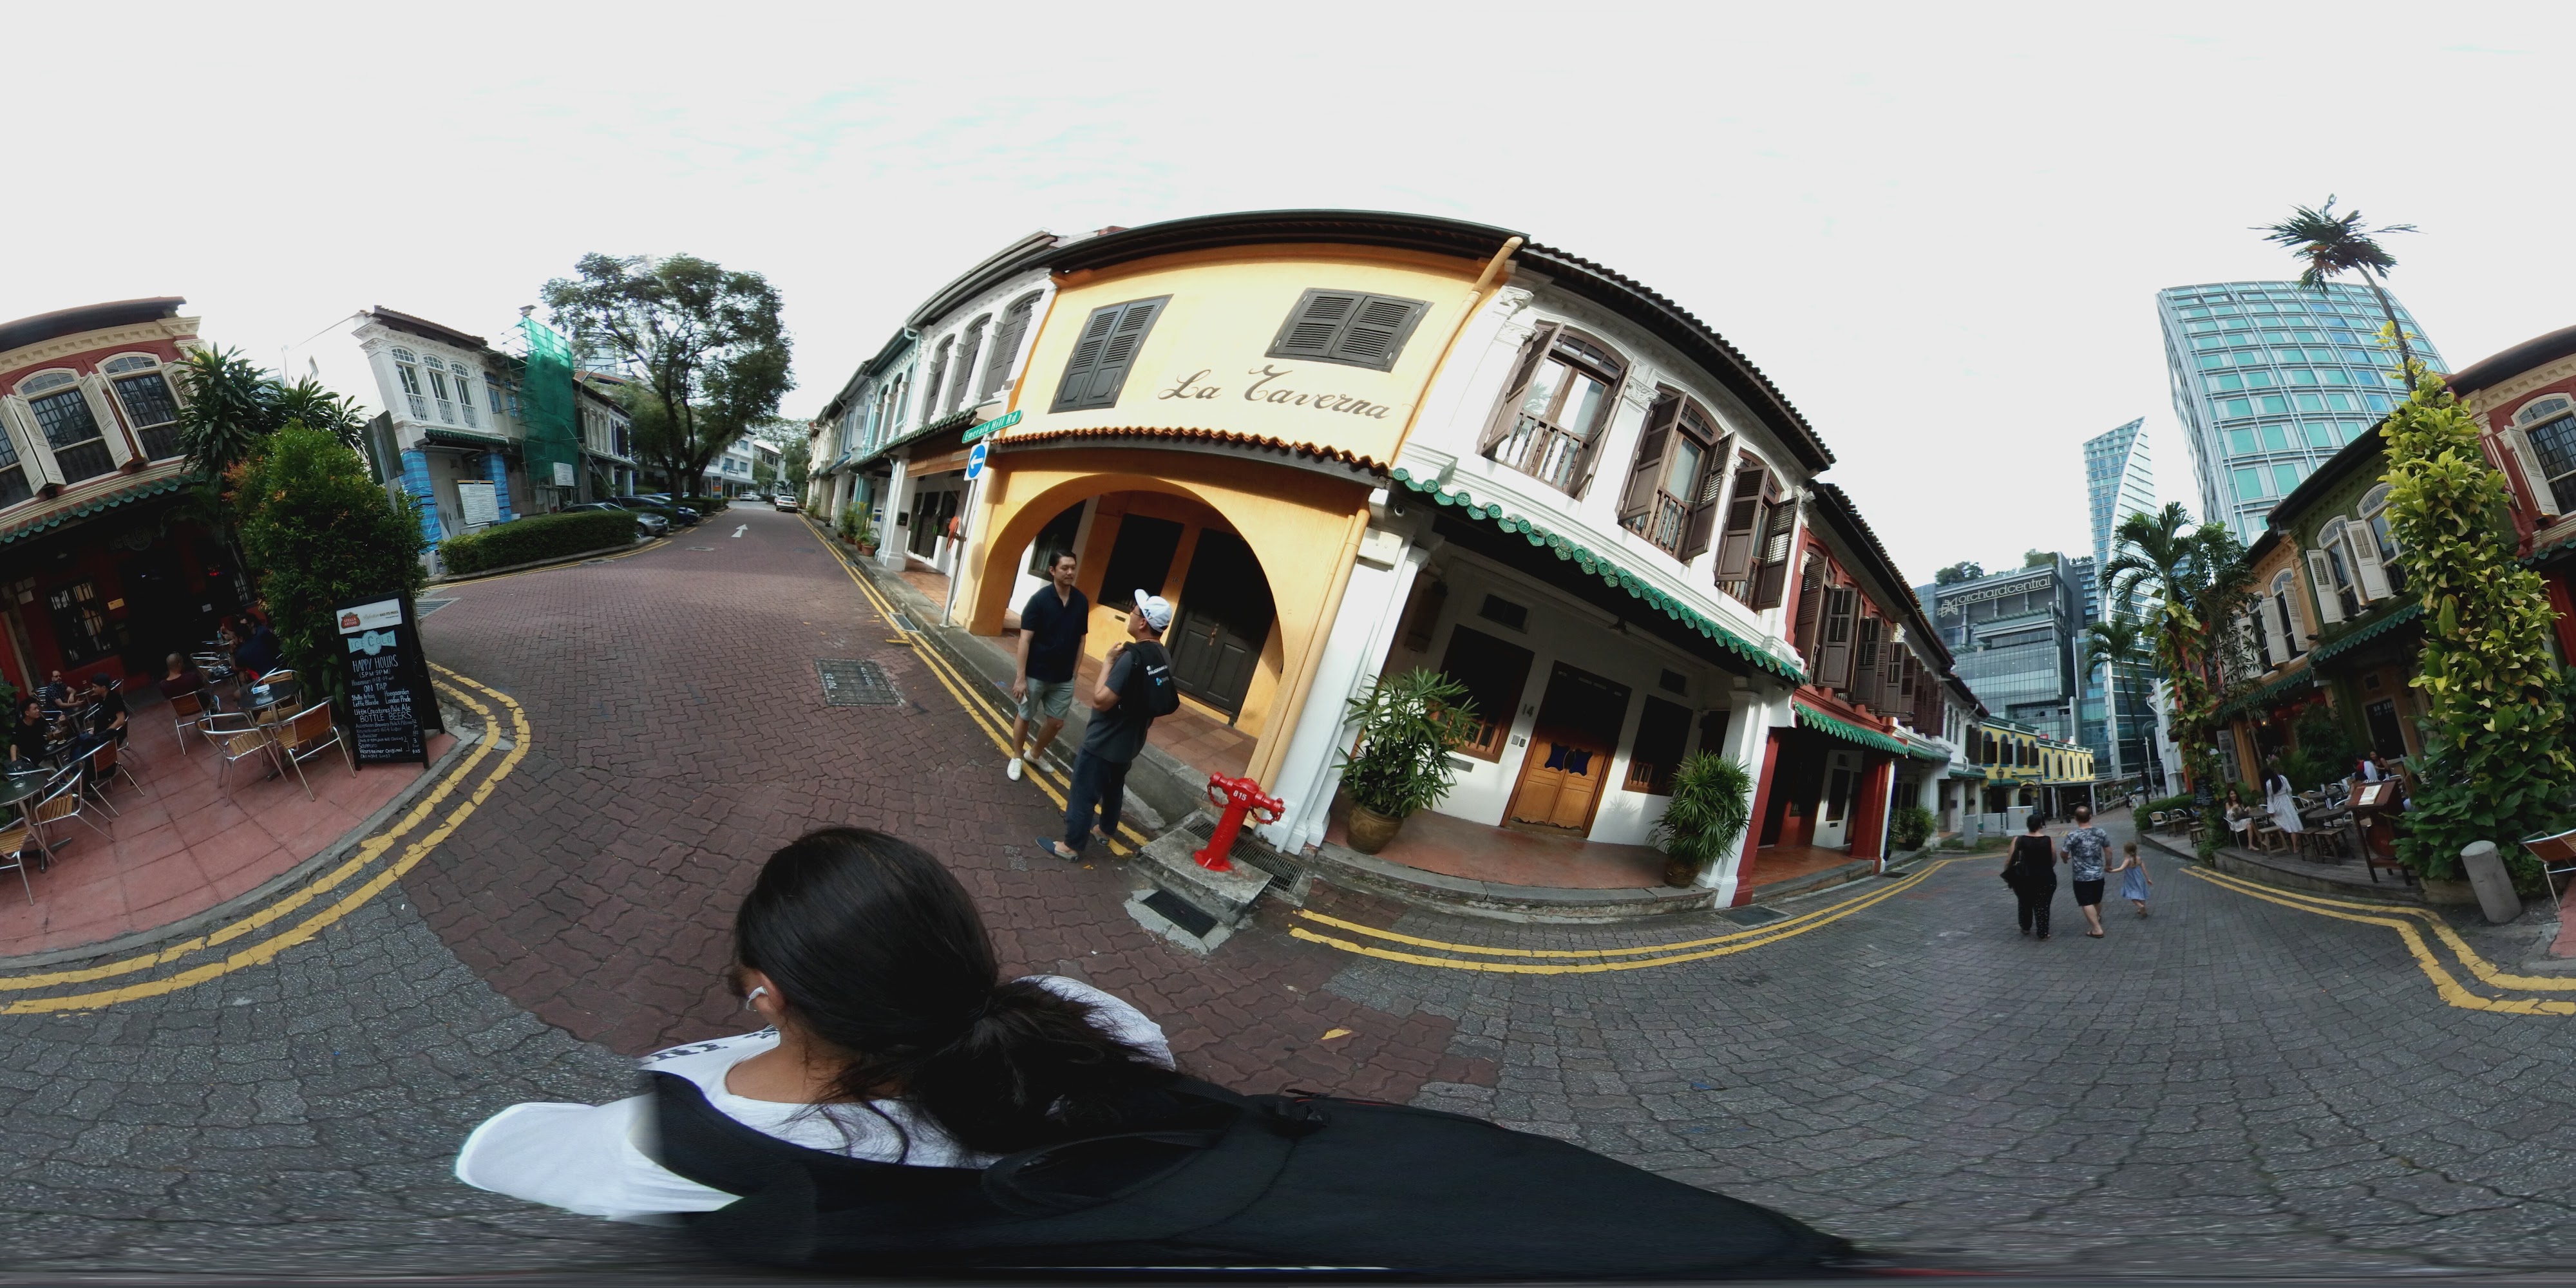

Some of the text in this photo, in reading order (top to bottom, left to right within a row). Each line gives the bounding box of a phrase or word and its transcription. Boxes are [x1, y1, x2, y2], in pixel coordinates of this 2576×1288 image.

[1157, 365, 1390, 420] La Taverna
[964, 412, 1018, 440] Emerald Hill Rd
[1958, 576, 2051, 603] orchardcentral
[351, 635, 392, 649] ICE COLD
[352, 654, 398, 672] HAPPY HOURS
[375, 683, 387, 691] TAP
[384, 688, 410, 697] Hoegaarden
[360, 710, 412, 723] BOTTLE BEERS
[1522, 703, 1535, 717] 14
